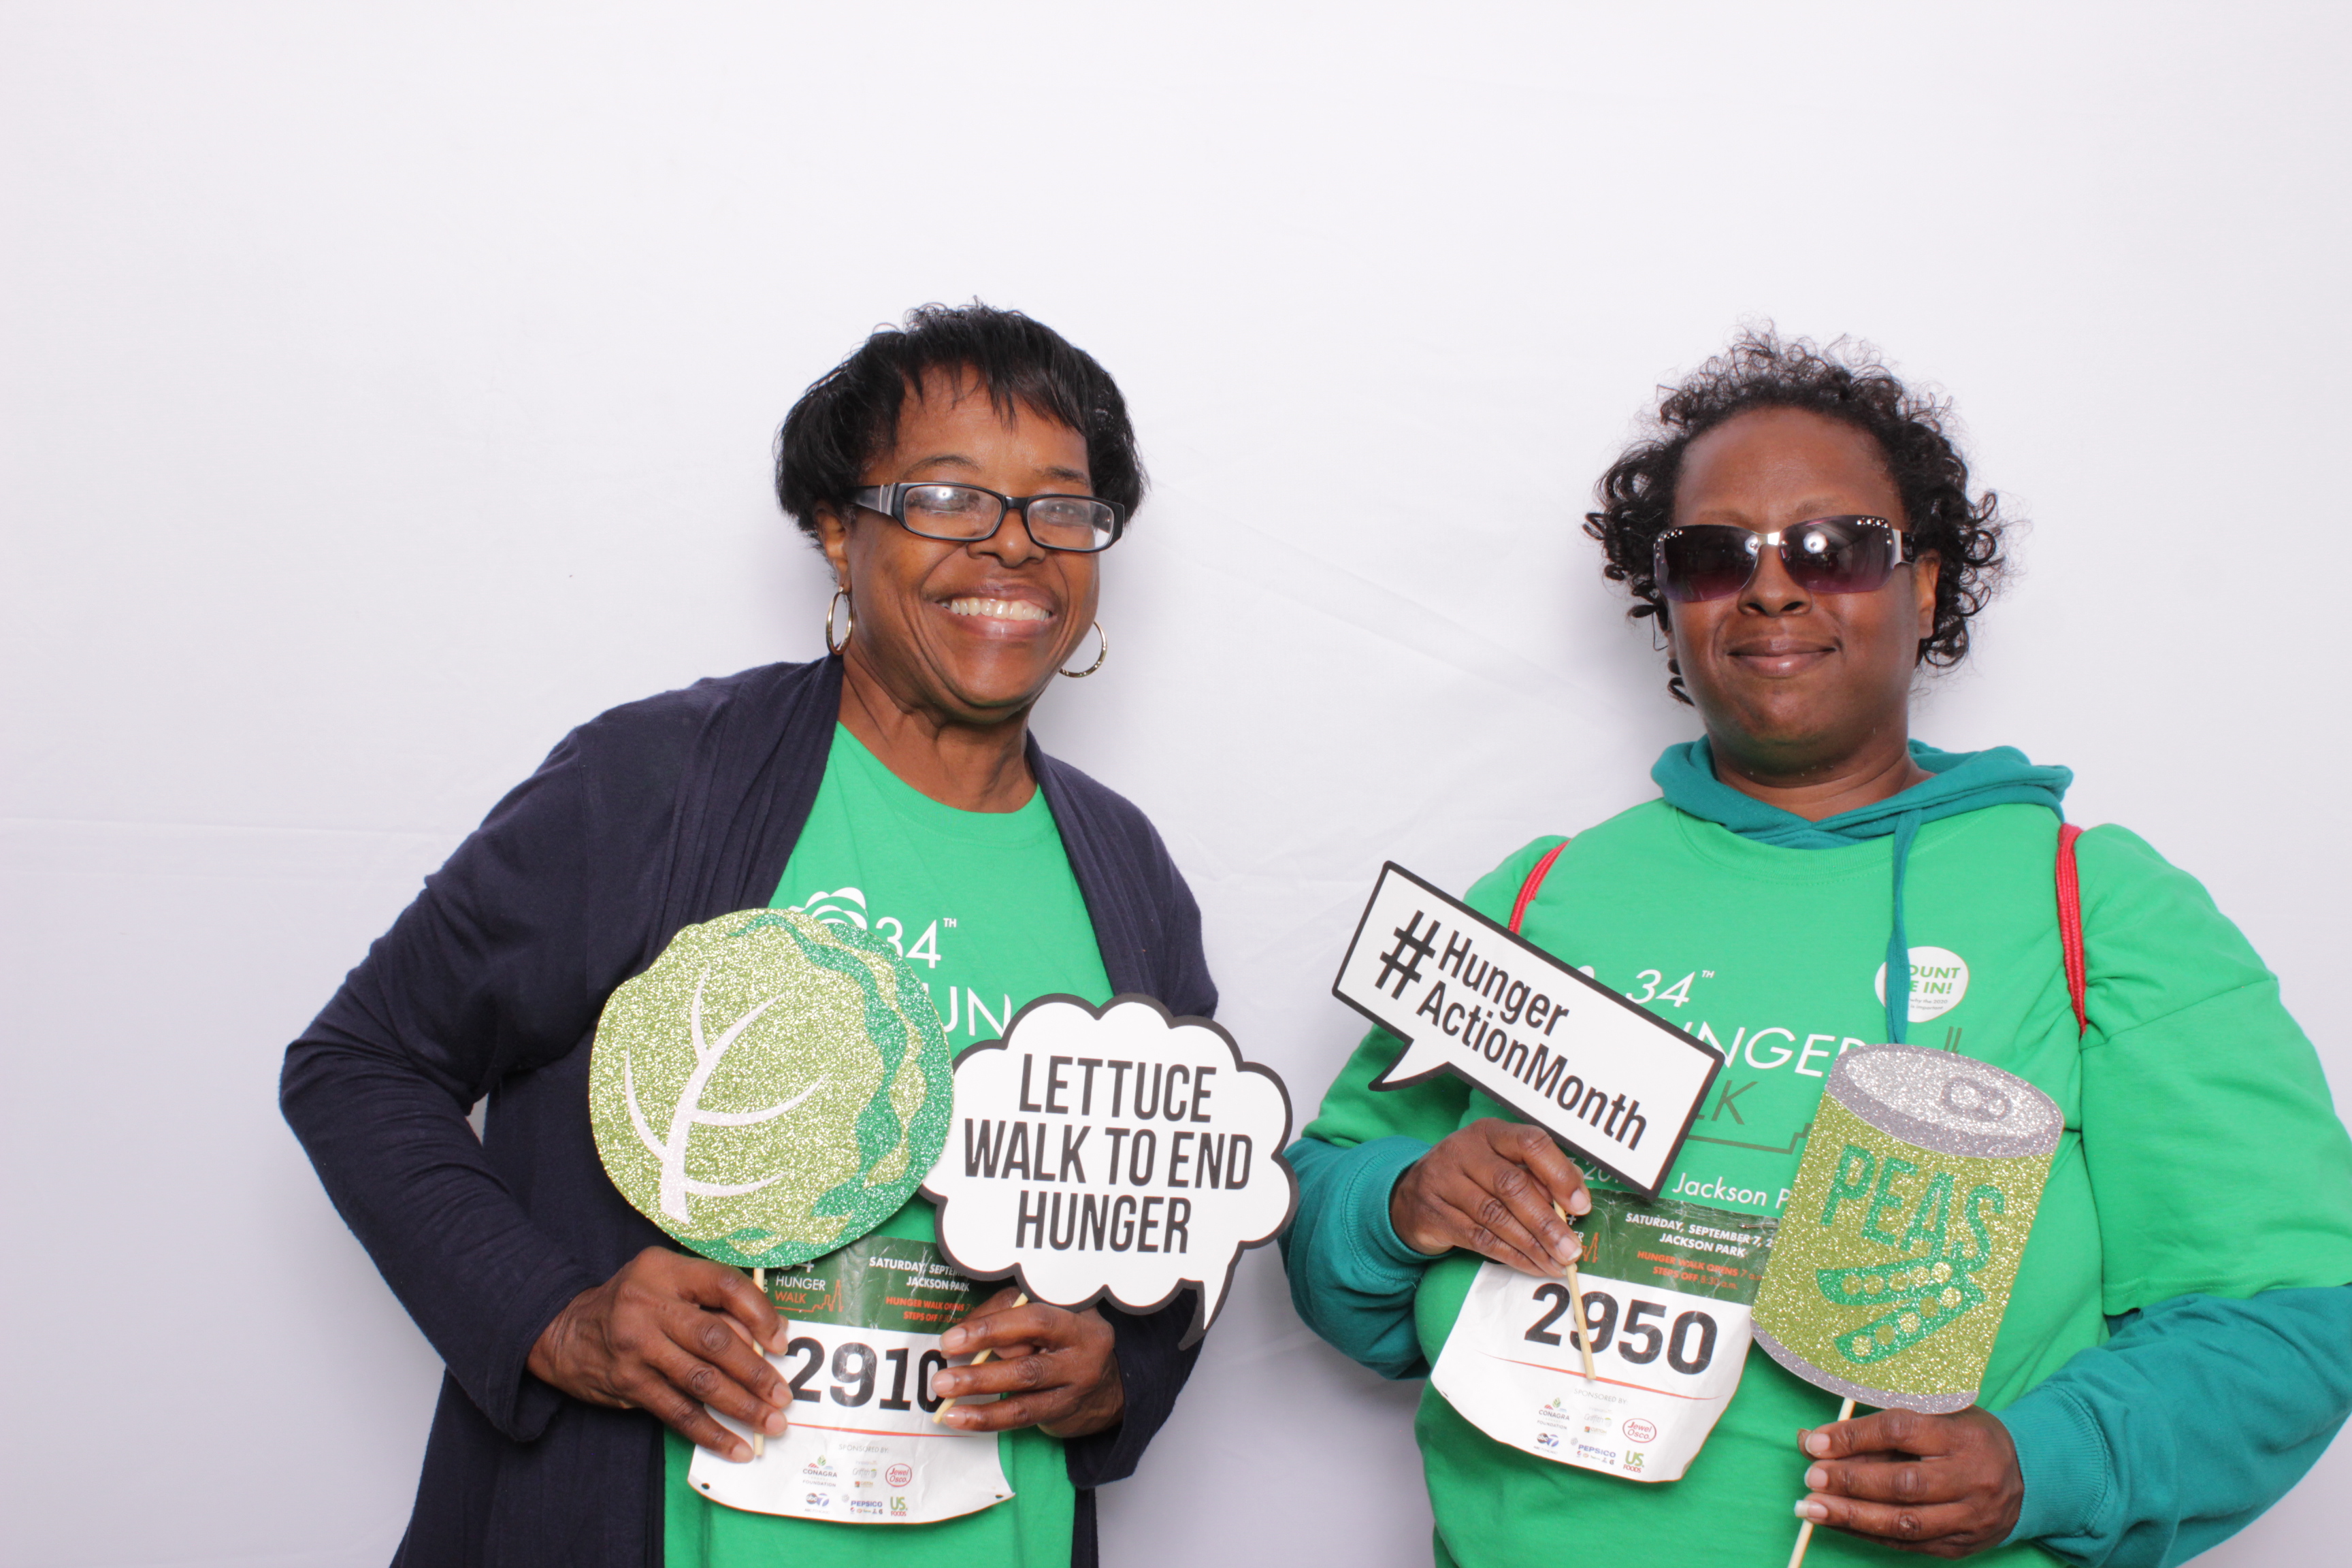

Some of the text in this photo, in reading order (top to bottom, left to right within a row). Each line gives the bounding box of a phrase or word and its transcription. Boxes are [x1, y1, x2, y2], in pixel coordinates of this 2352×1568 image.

[1910, 964, 1961, 979] OUNT
[1923, 981, 1953, 994] IN!
[1415, 981, 1647, 1151] ActionMonth
[1019, 1054, 1217, 1123] LETTUCE
[965, 1118, 1253, 1190] WALK TO END
[1672, 1173, 1767, 1206] Jackson
[1820, 1143, 2004, 1273] PEAS
[1015, 1190, 1192, 1254] HUNGER
[1625, 1213, 1684, 1232] SATURDAY,
[1688, 1224, 1750, 1244] SEPTEMBER
[1659, 1233, 1747, 1258] JACKSON PARK
[1637, 1250, 1677, 1264] HUNGER
[1678, 1259, 1705, 1270] WALK
[1707, 1264, 1739, 1277] OPENS
[1740, 1269, 1748, 1277] 7
[1652, 1266, 1679, 1278] STEPS
[1681, 1272, 1699, 1282] OFF
[776, 1275, 826, 1291] HUNGER
[906, 1276, 970, 1292] JACKSON PARK
[774, 1290, 807, 1304] WALK
[885, 1296, 922, 1307] HUNGER
[924, 1301, 943, 1310] WALK
[903, 1311, 925, 1321] STEPS
[926, 1314, 938, 1322] OFF
[1524, 1282, 1718, 1375] 2950
[786, 1337, 949, 1414] 2910
[1574, 1388, 1616, 1403] SPONSORED
[1539, 1409, 1570, 1420] CONAGRA
[1537, 1420, 1567, 1430] FOUNDATION
[1628, 1422, 1652, 1433] Jewel
[838, 1443, 879, 1453] SPONSORED
[1578, 1444, 1616, 1458] PEPSICO
[802, 1468, 838, 1478] CONAGRA
[1623, 1465, 1642, 1473] FOODS
